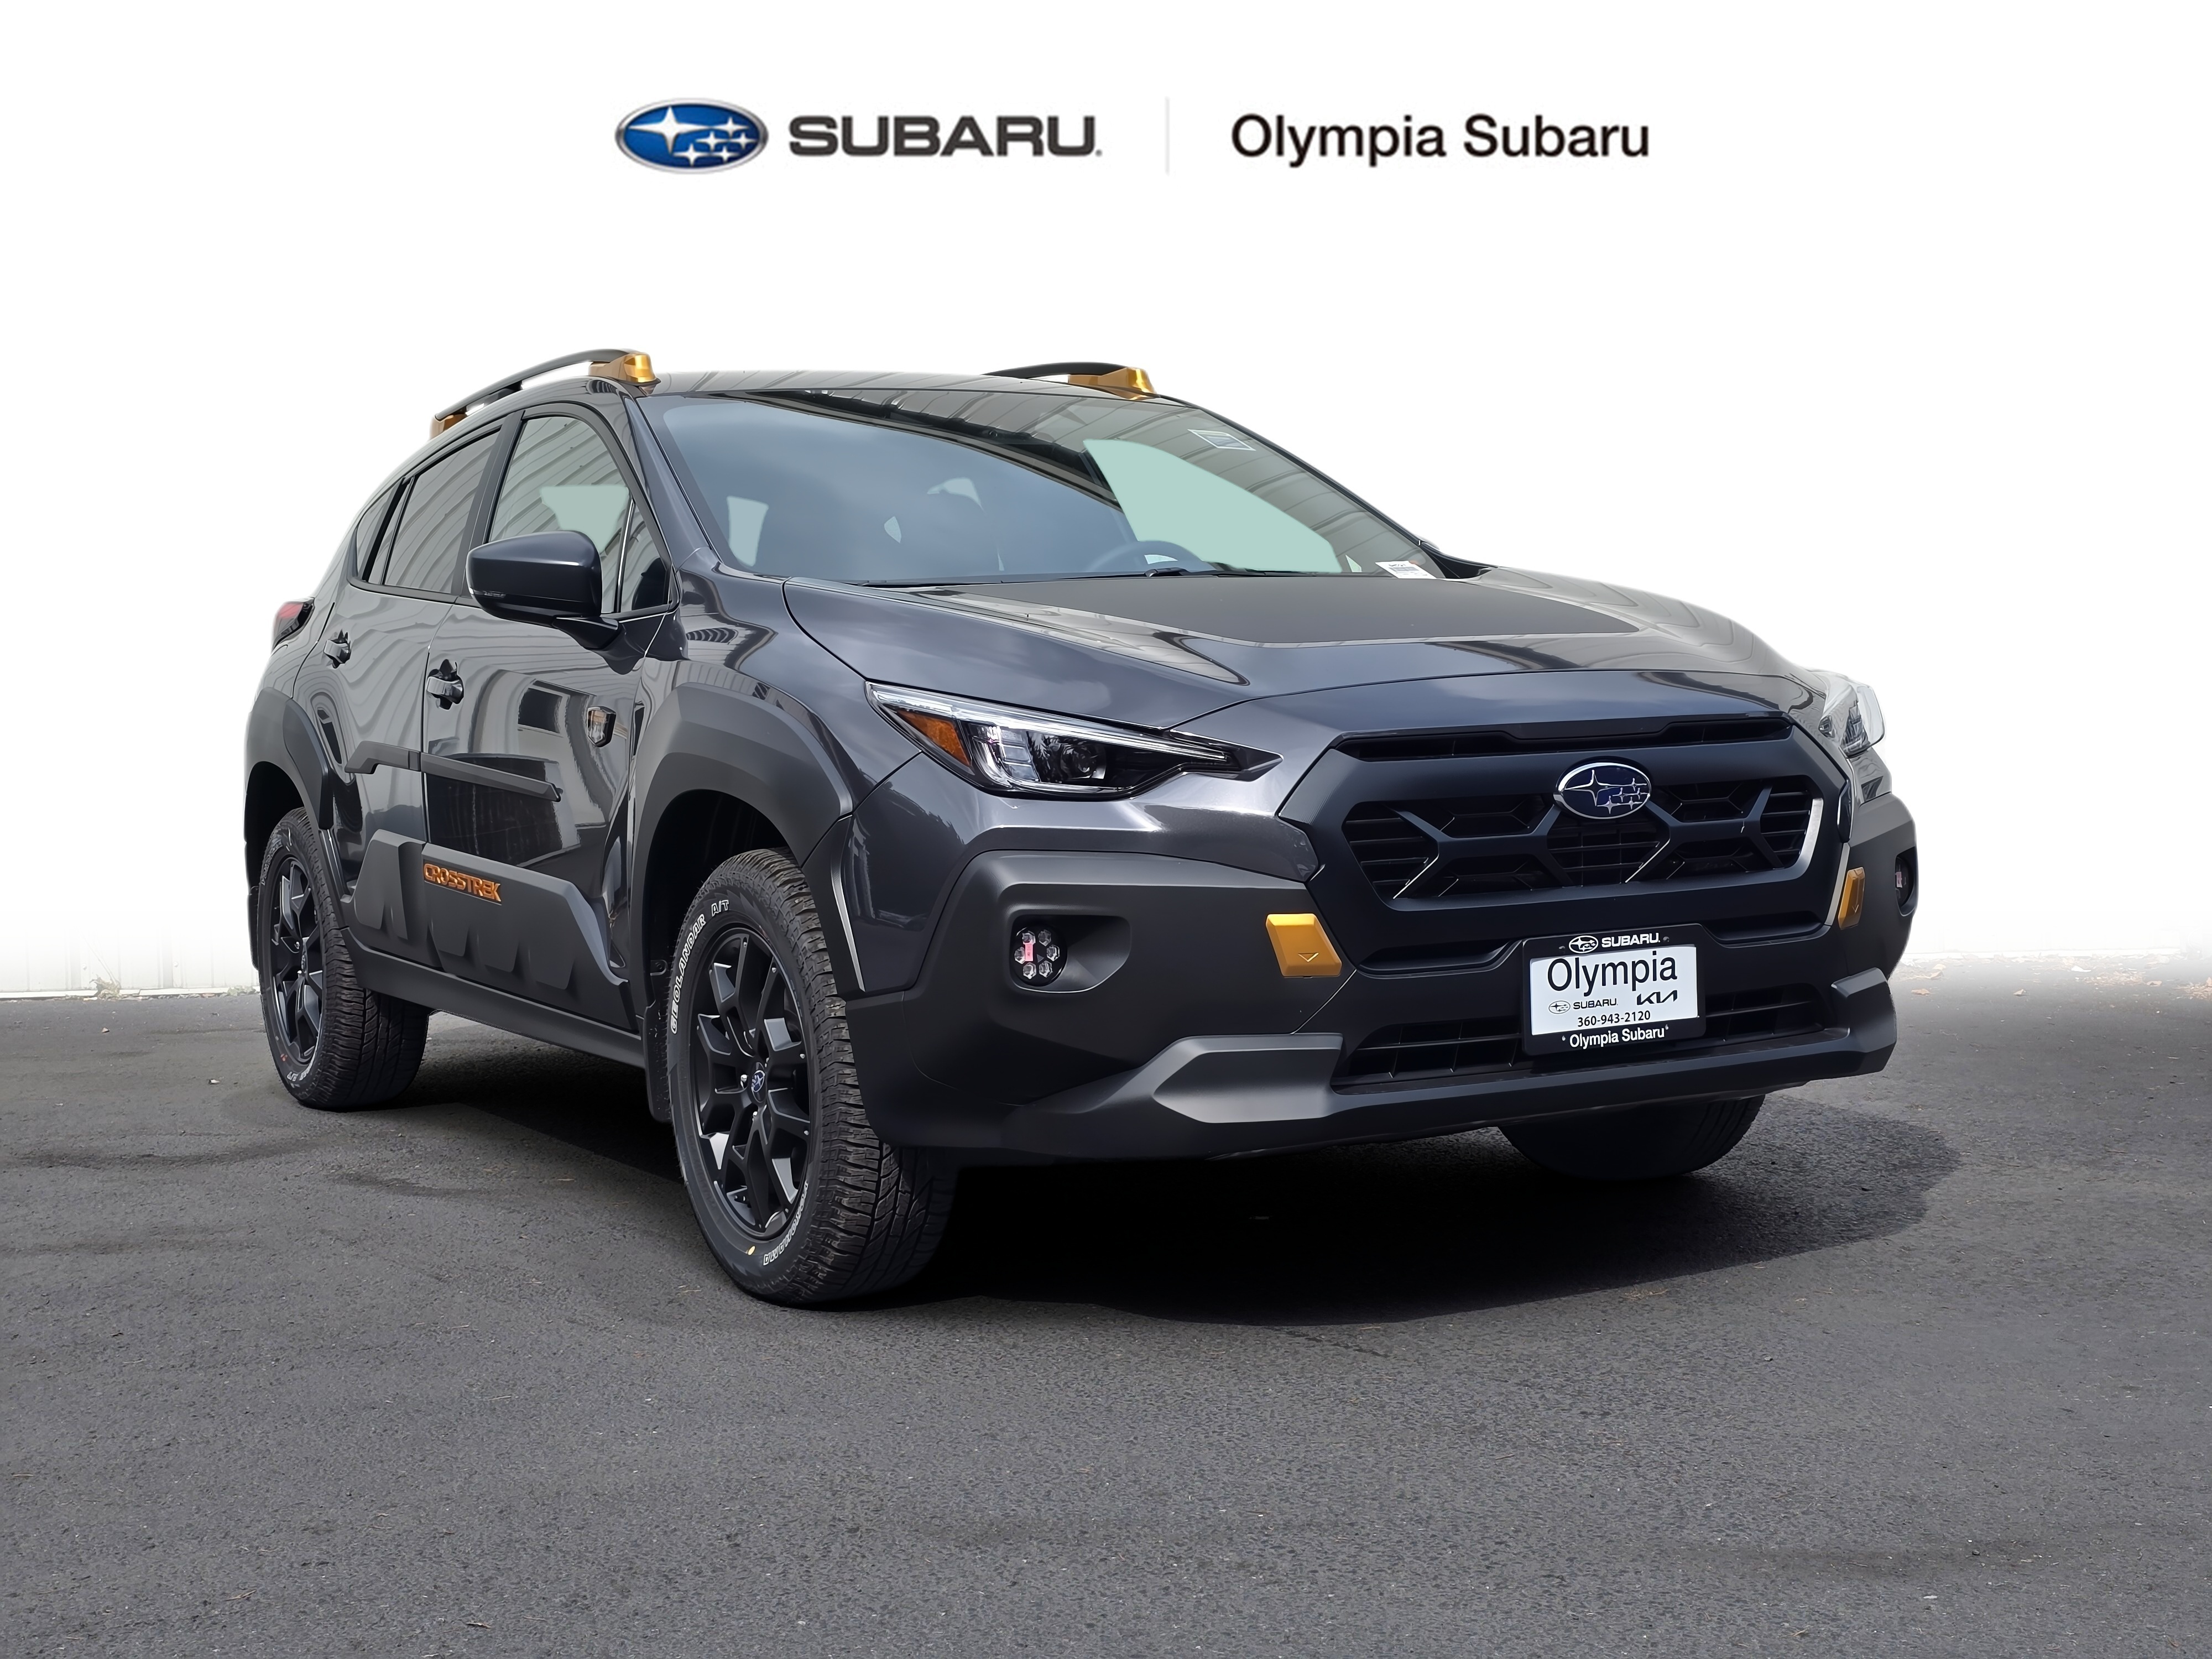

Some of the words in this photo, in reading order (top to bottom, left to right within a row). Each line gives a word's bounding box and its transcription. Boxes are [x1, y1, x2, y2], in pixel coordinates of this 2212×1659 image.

[424, 863, 502, 902] CROSSTREK
[670, 914, 707, 1034] GEOLANDAR
[711, 899, 729, 916] A/T
[1547, 950, 1678, 997] Olympia
[1636, 990, 1678, 1005] KIA
[1577, 1010, 1651, 1027] 360-943-2120
[1569, 1030, 1619, 1050] Olympia
[1621, 1028, 1665, 1042] Subaru
[763, 1179, 809, 1266] YOKOHAMA
